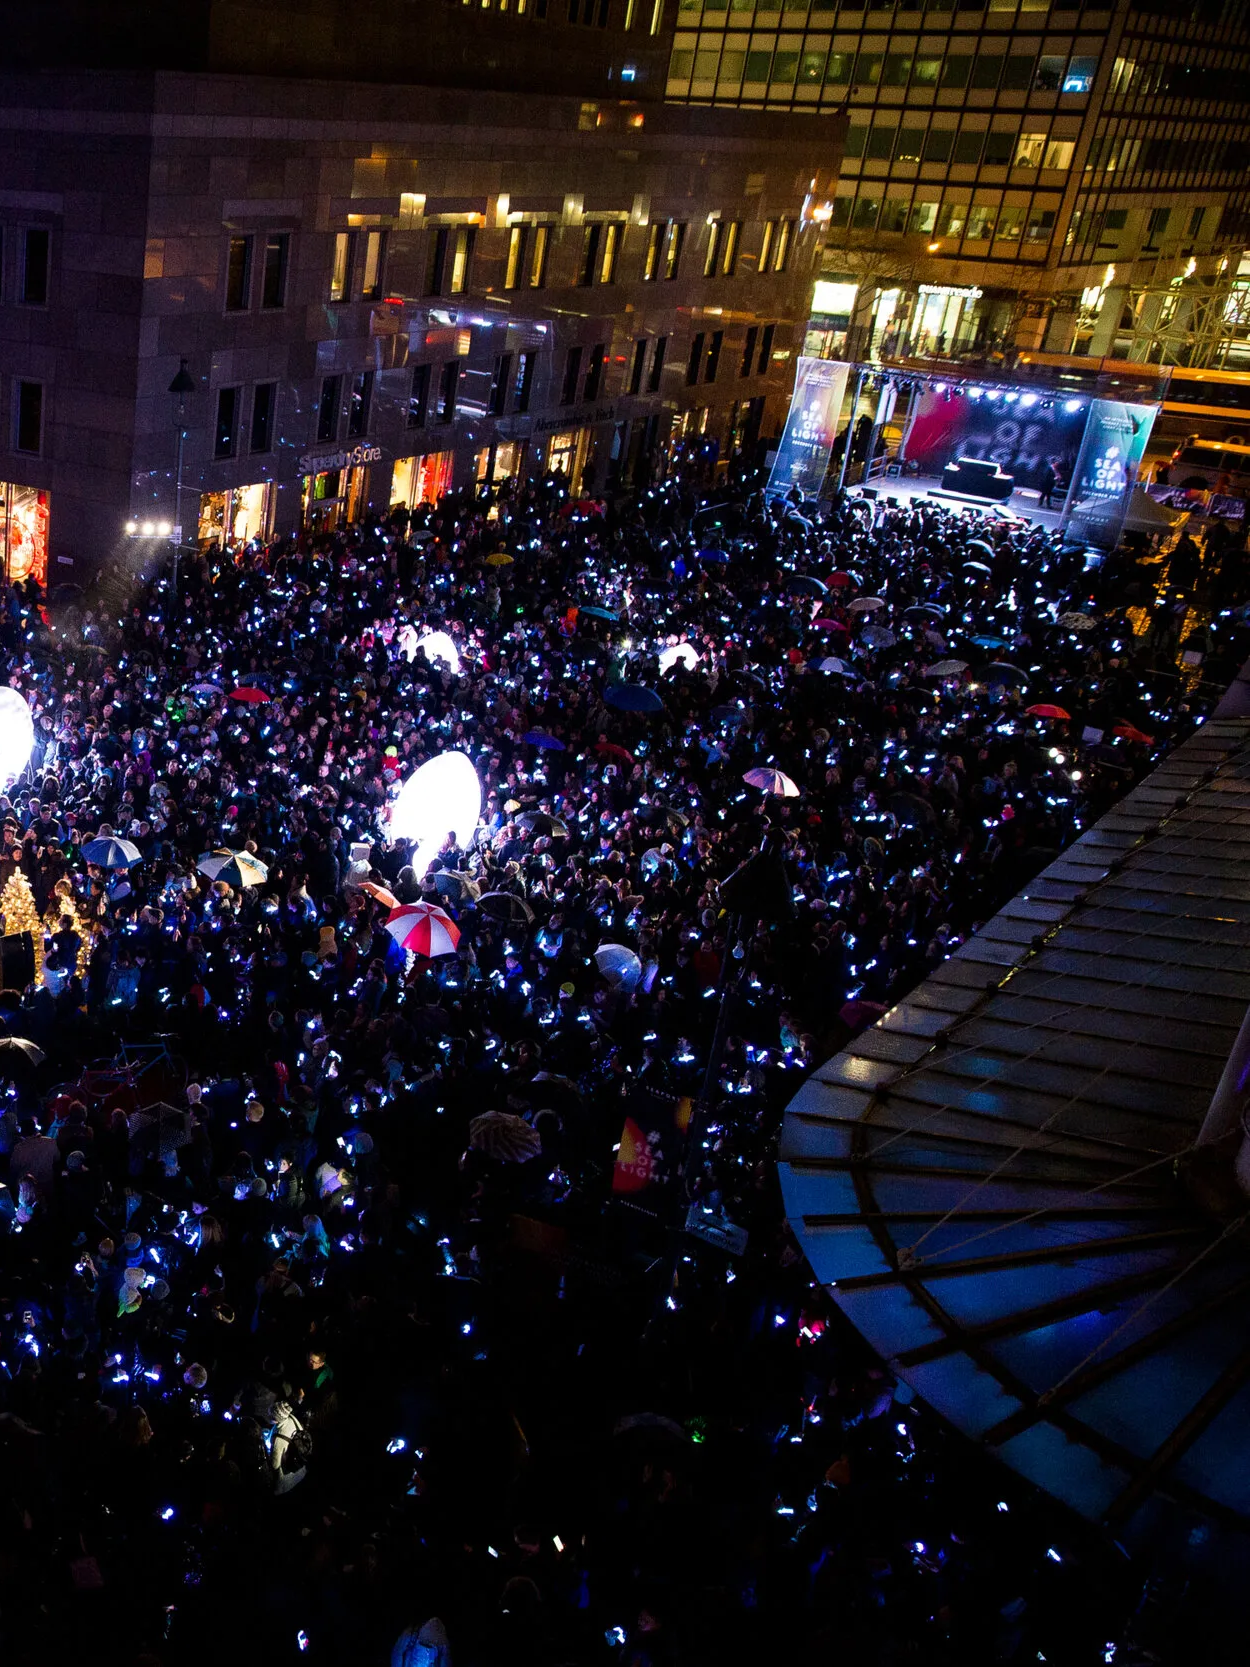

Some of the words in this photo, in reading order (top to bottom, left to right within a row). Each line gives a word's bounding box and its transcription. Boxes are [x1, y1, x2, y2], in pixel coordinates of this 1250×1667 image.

[802, 410, 823, 422] SEA
[803, 420, 819, 431] OF
[791, 428, 827, 441] LIGHT
[1094, 458, 1121, 472] SEA
[1096, 469, 1116, 480] OF
[1081, 476, 1127, 491] LIGHT
[635, 1141, 664, 1161] SEA
[638, 1155, 658, 1170] OF
[619, 1162, 670, 1185] LIGHT
